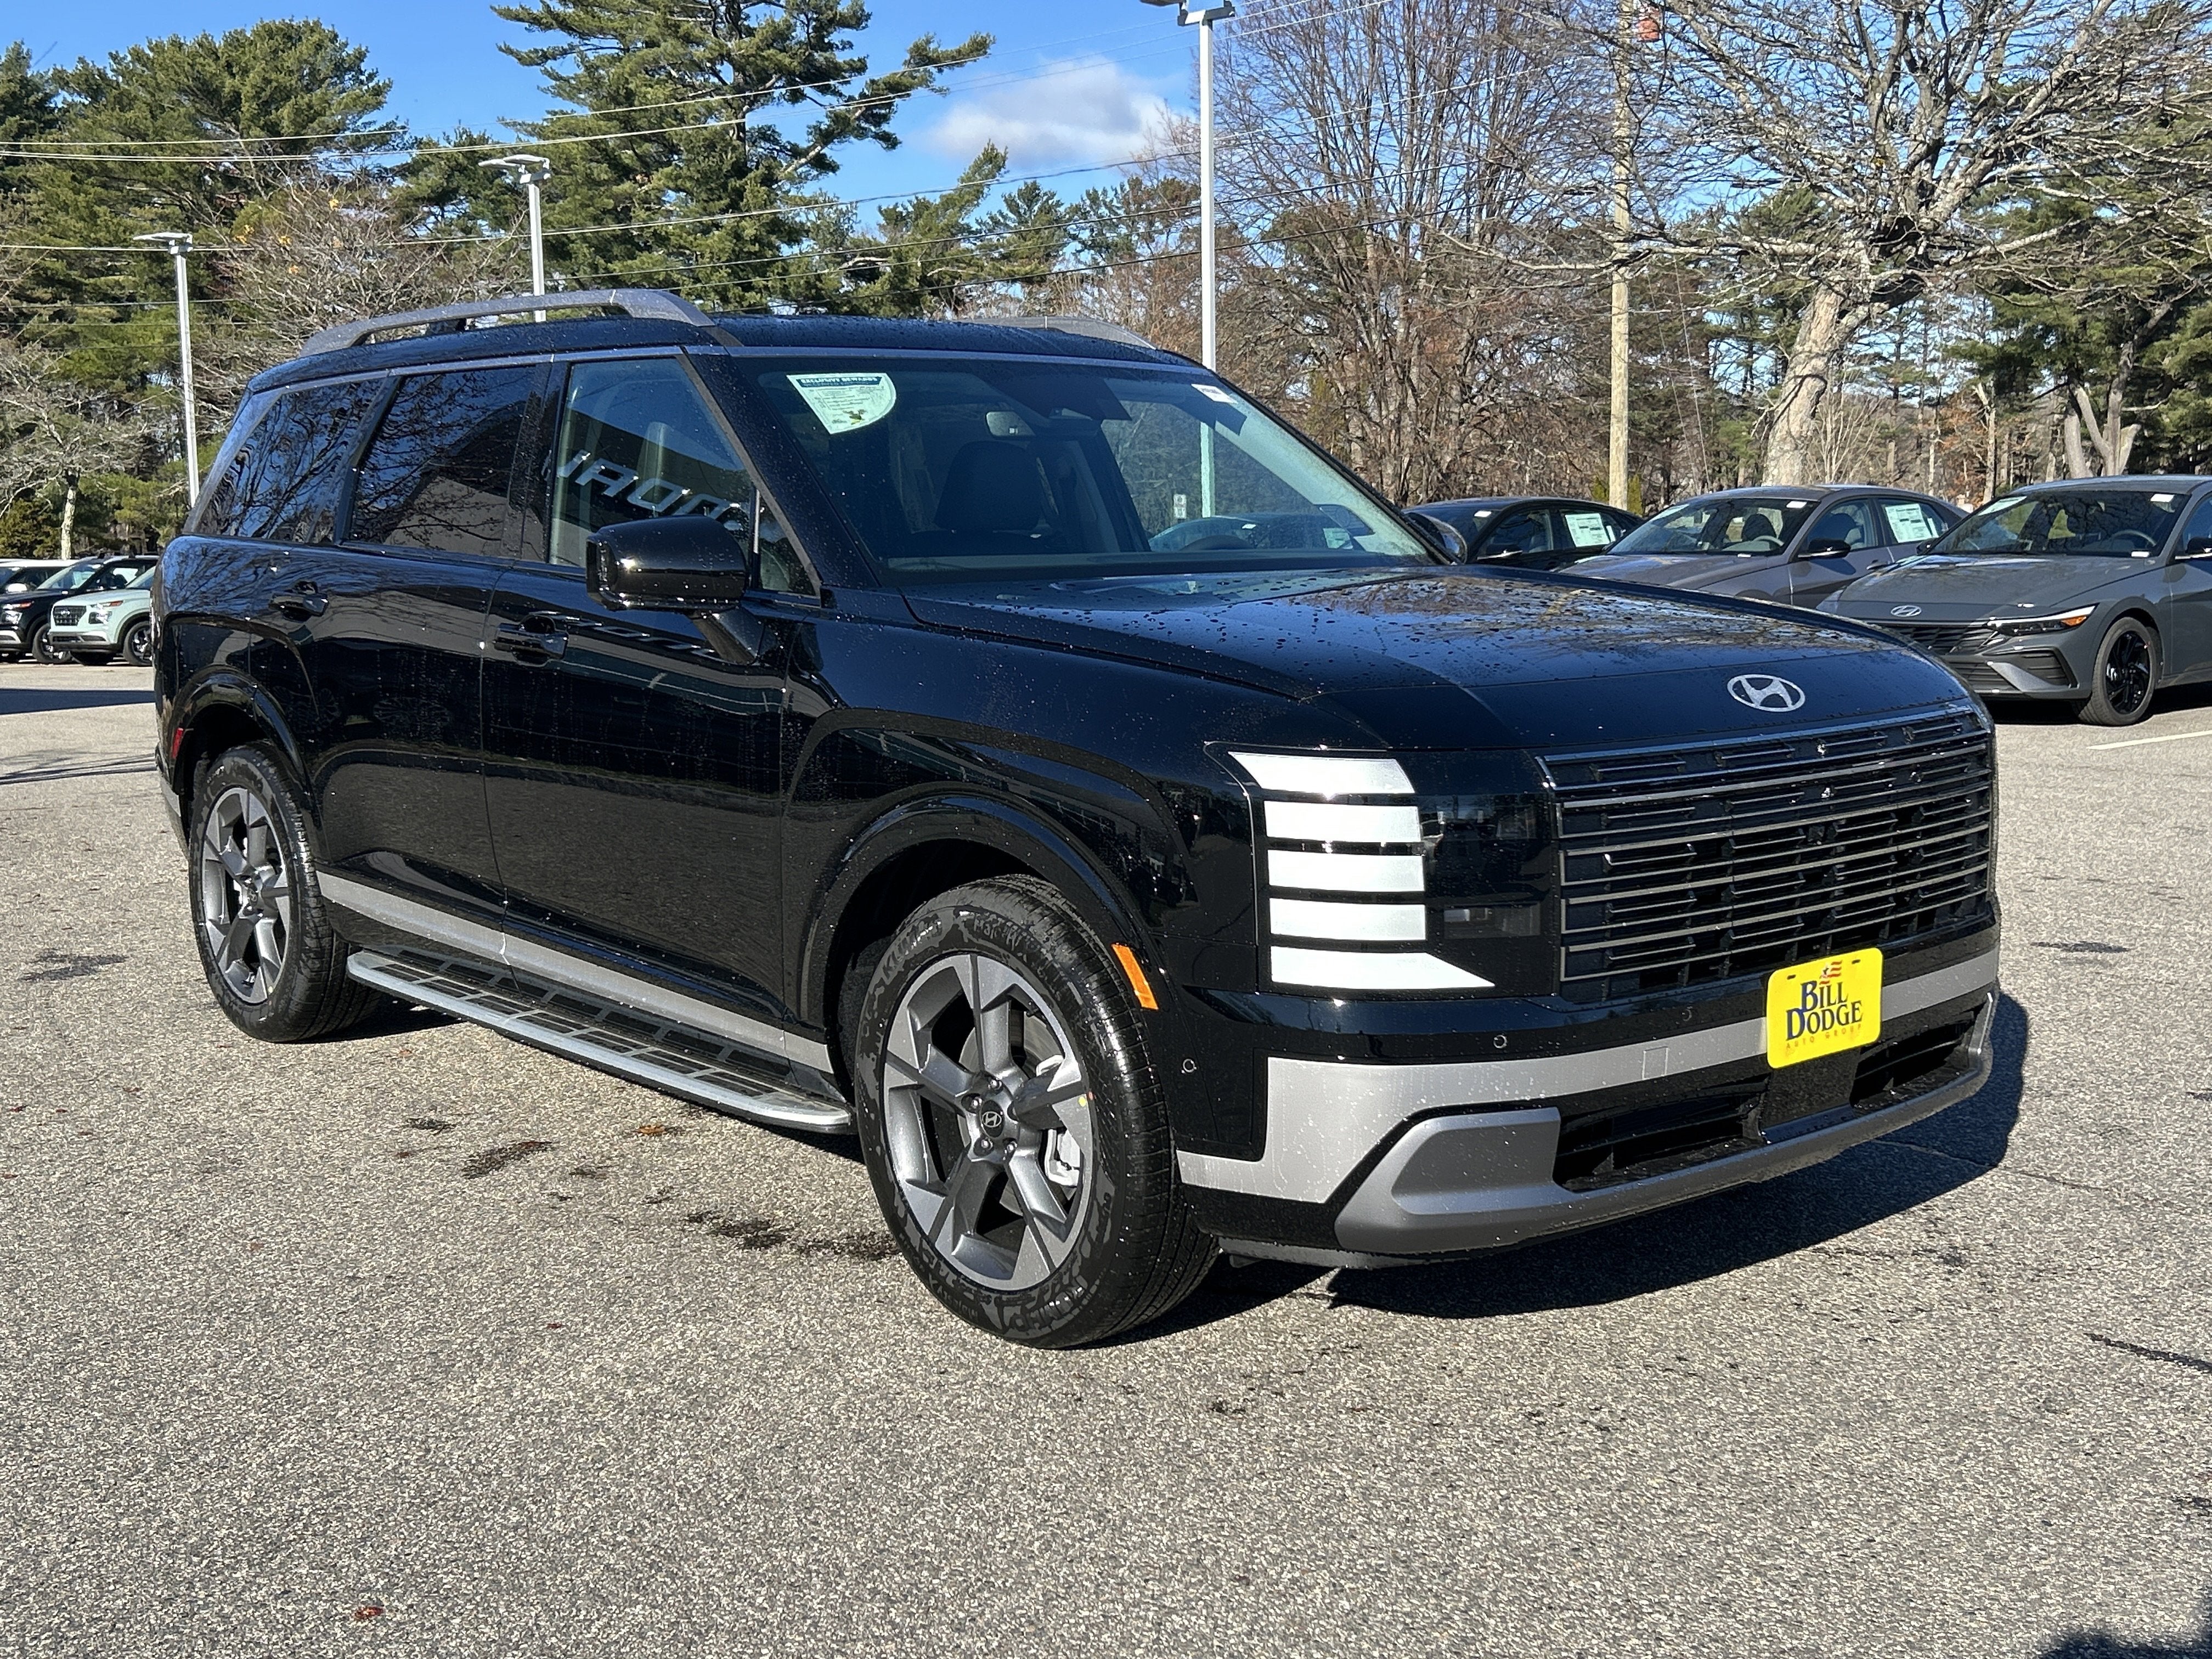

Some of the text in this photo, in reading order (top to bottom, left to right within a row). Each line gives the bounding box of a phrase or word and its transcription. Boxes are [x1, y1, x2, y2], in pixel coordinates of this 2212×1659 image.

[1801, 980, 1849, 1012] BILL
[1786, 1000, 1863, 1041] DODGE
[1786, 1023, 1862, 1049] AUTO GROUP
